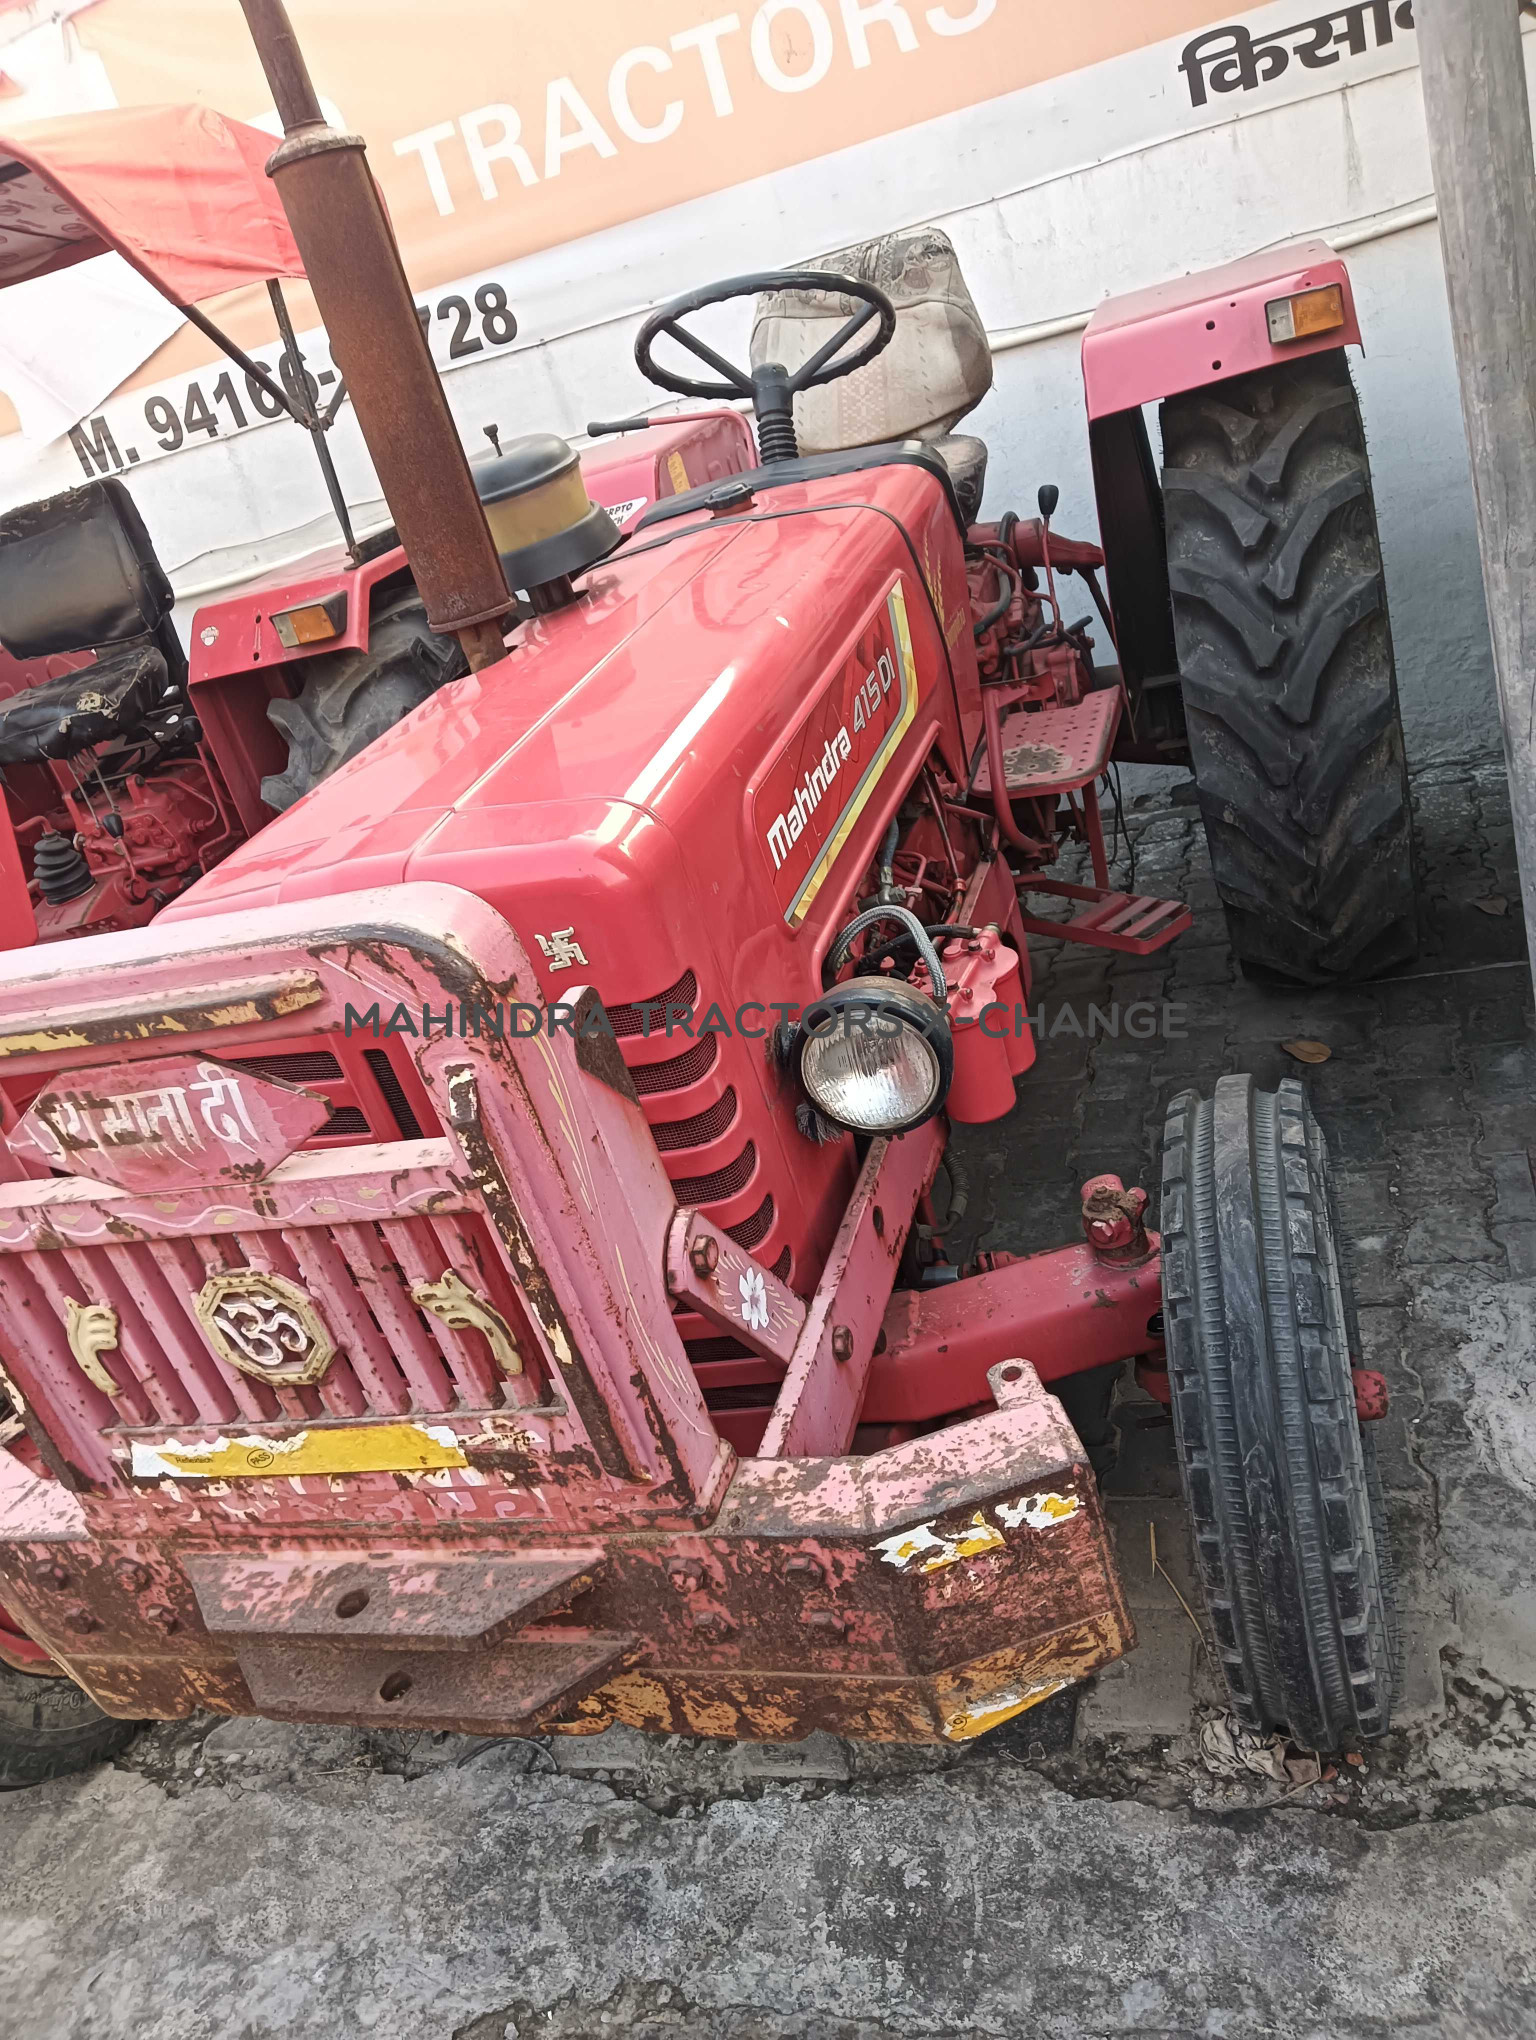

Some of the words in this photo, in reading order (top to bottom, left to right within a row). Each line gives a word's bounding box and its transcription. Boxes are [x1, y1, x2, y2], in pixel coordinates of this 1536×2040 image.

[68, 415, 141, 478] M.
[765, 725, 853, 871] Mahindra
[853, 669, 882, 733] 415
[877, 646, 896, 693] DI
[250, 1451, 271, 1466] PASS
